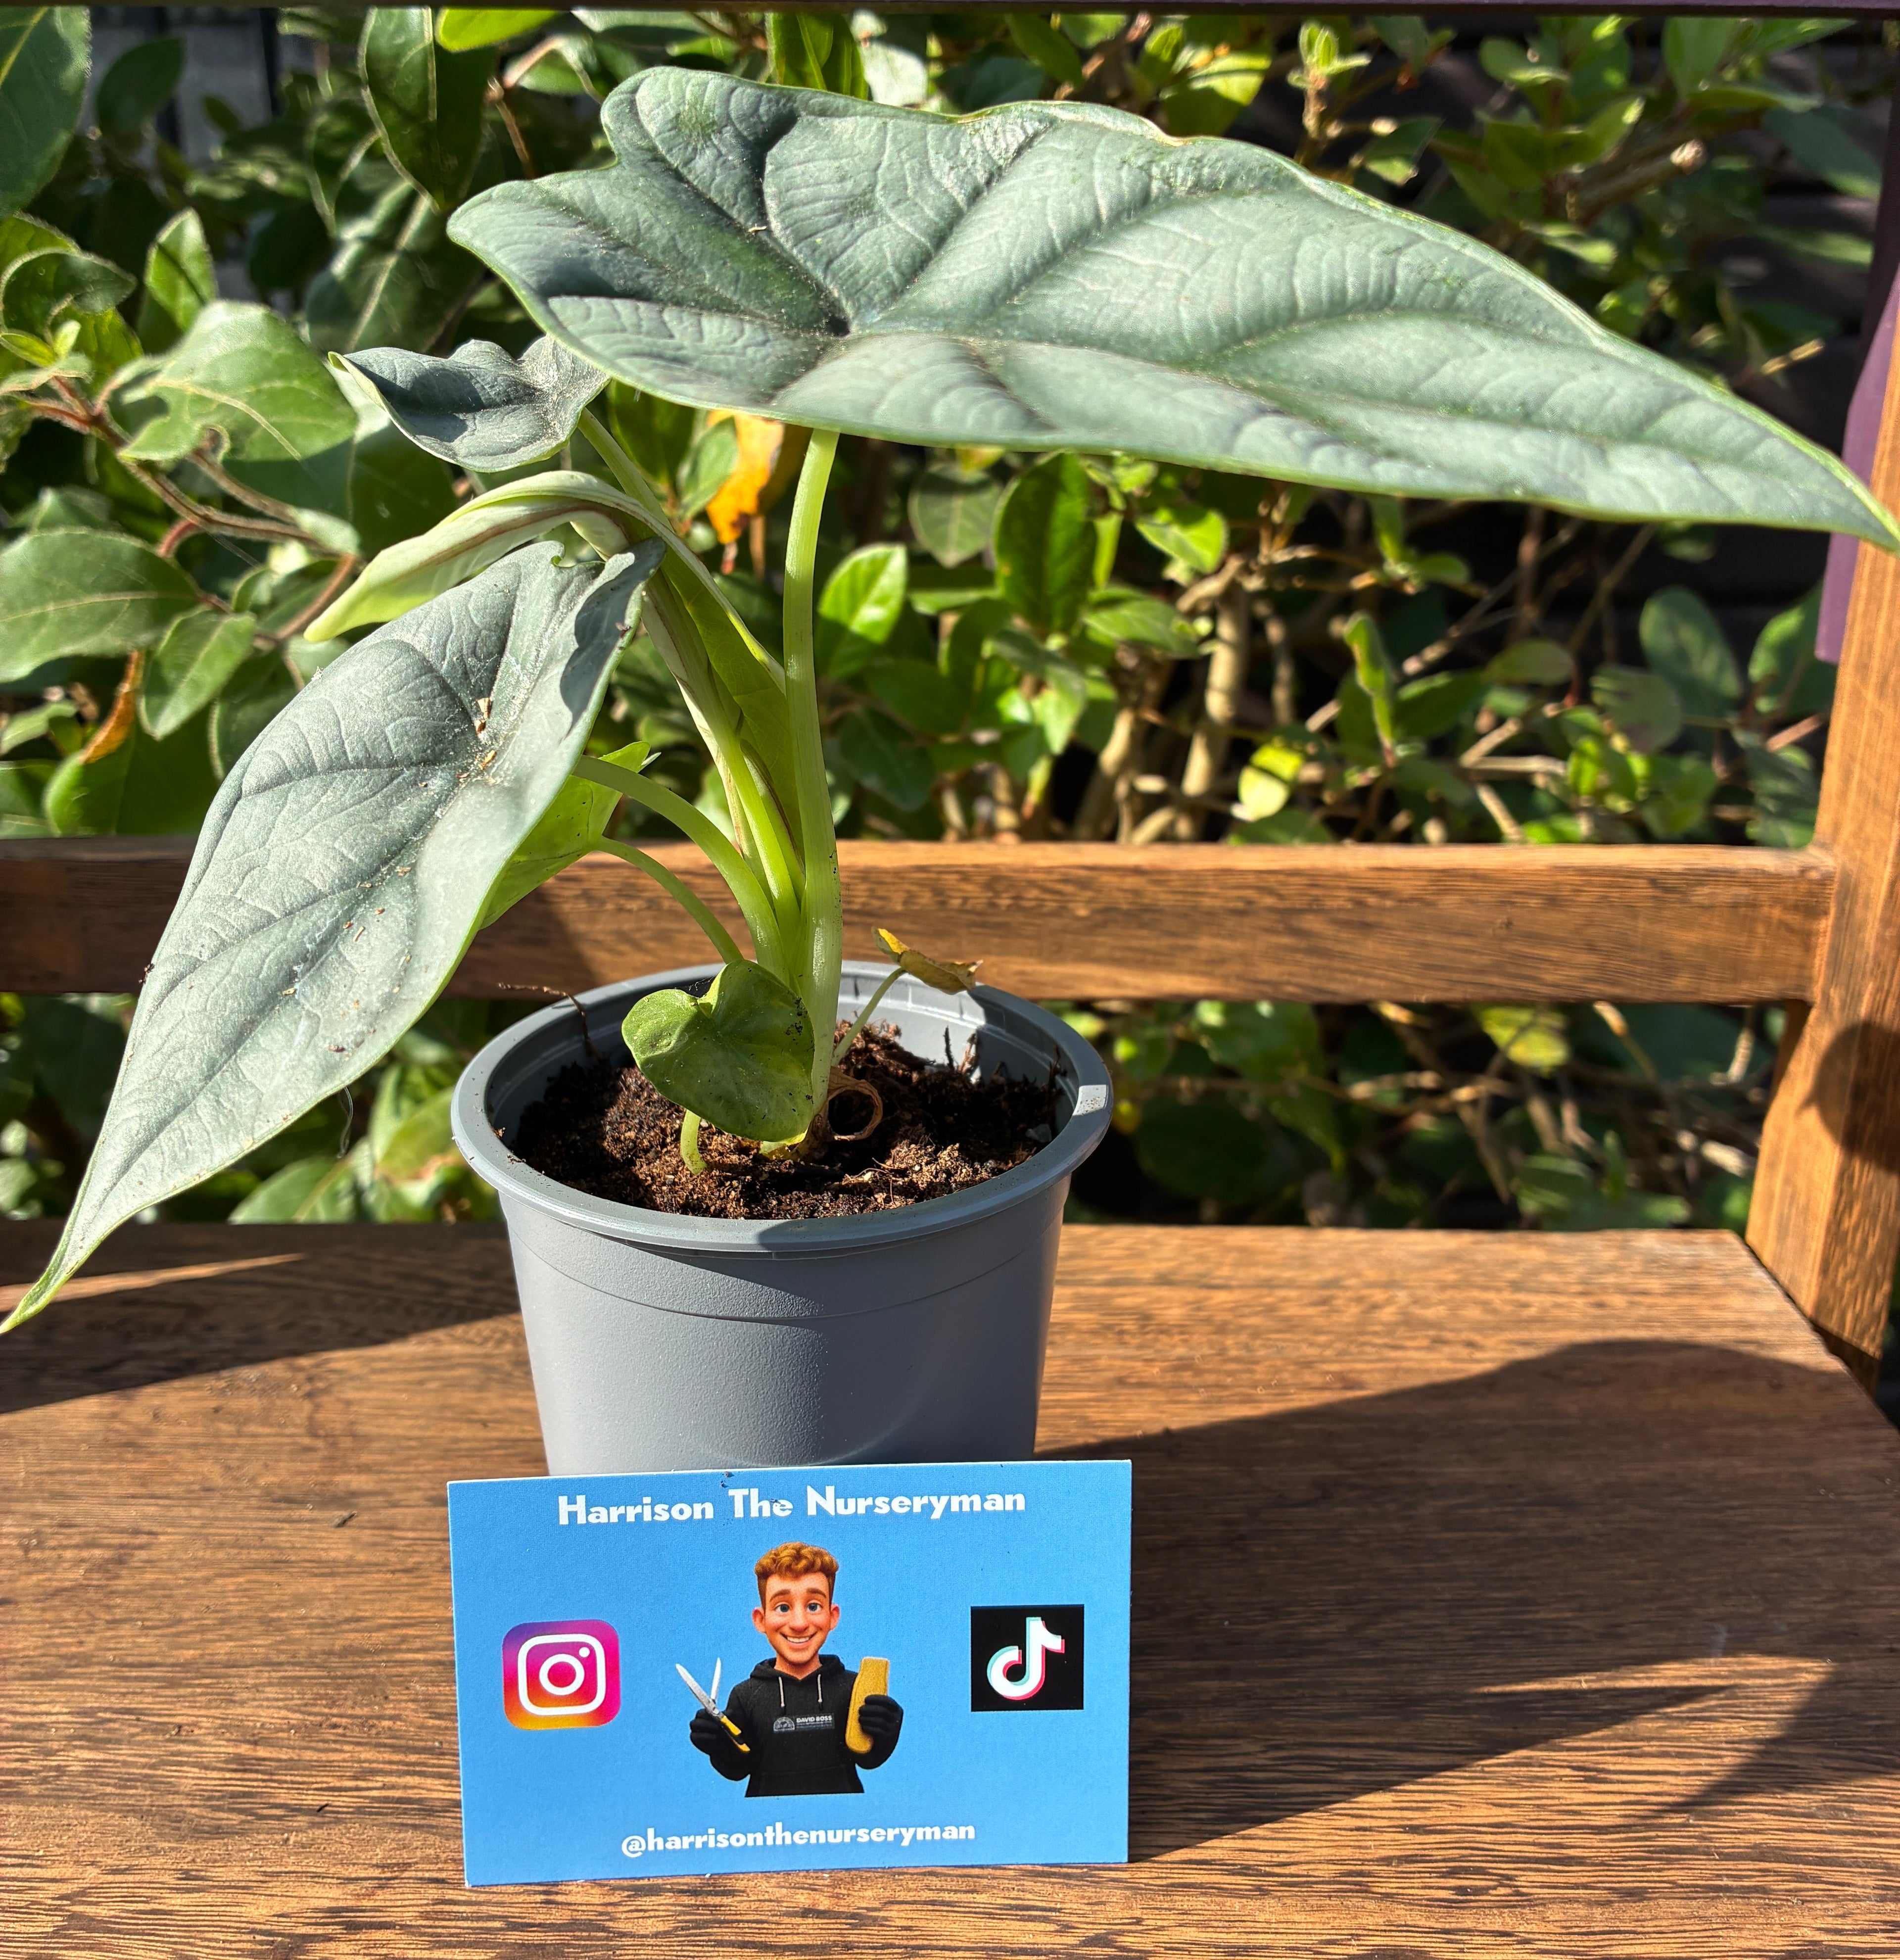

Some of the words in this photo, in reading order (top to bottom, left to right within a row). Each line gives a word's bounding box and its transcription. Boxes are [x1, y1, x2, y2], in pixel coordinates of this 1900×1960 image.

[559, 1495, 713, 1525] Harrison
[728, 1488, 793, 1518] The
[807, 1485, 1025, 1519] Nurseryman
[621, 1822, 975, 1858] @harrisonthenurseryman
